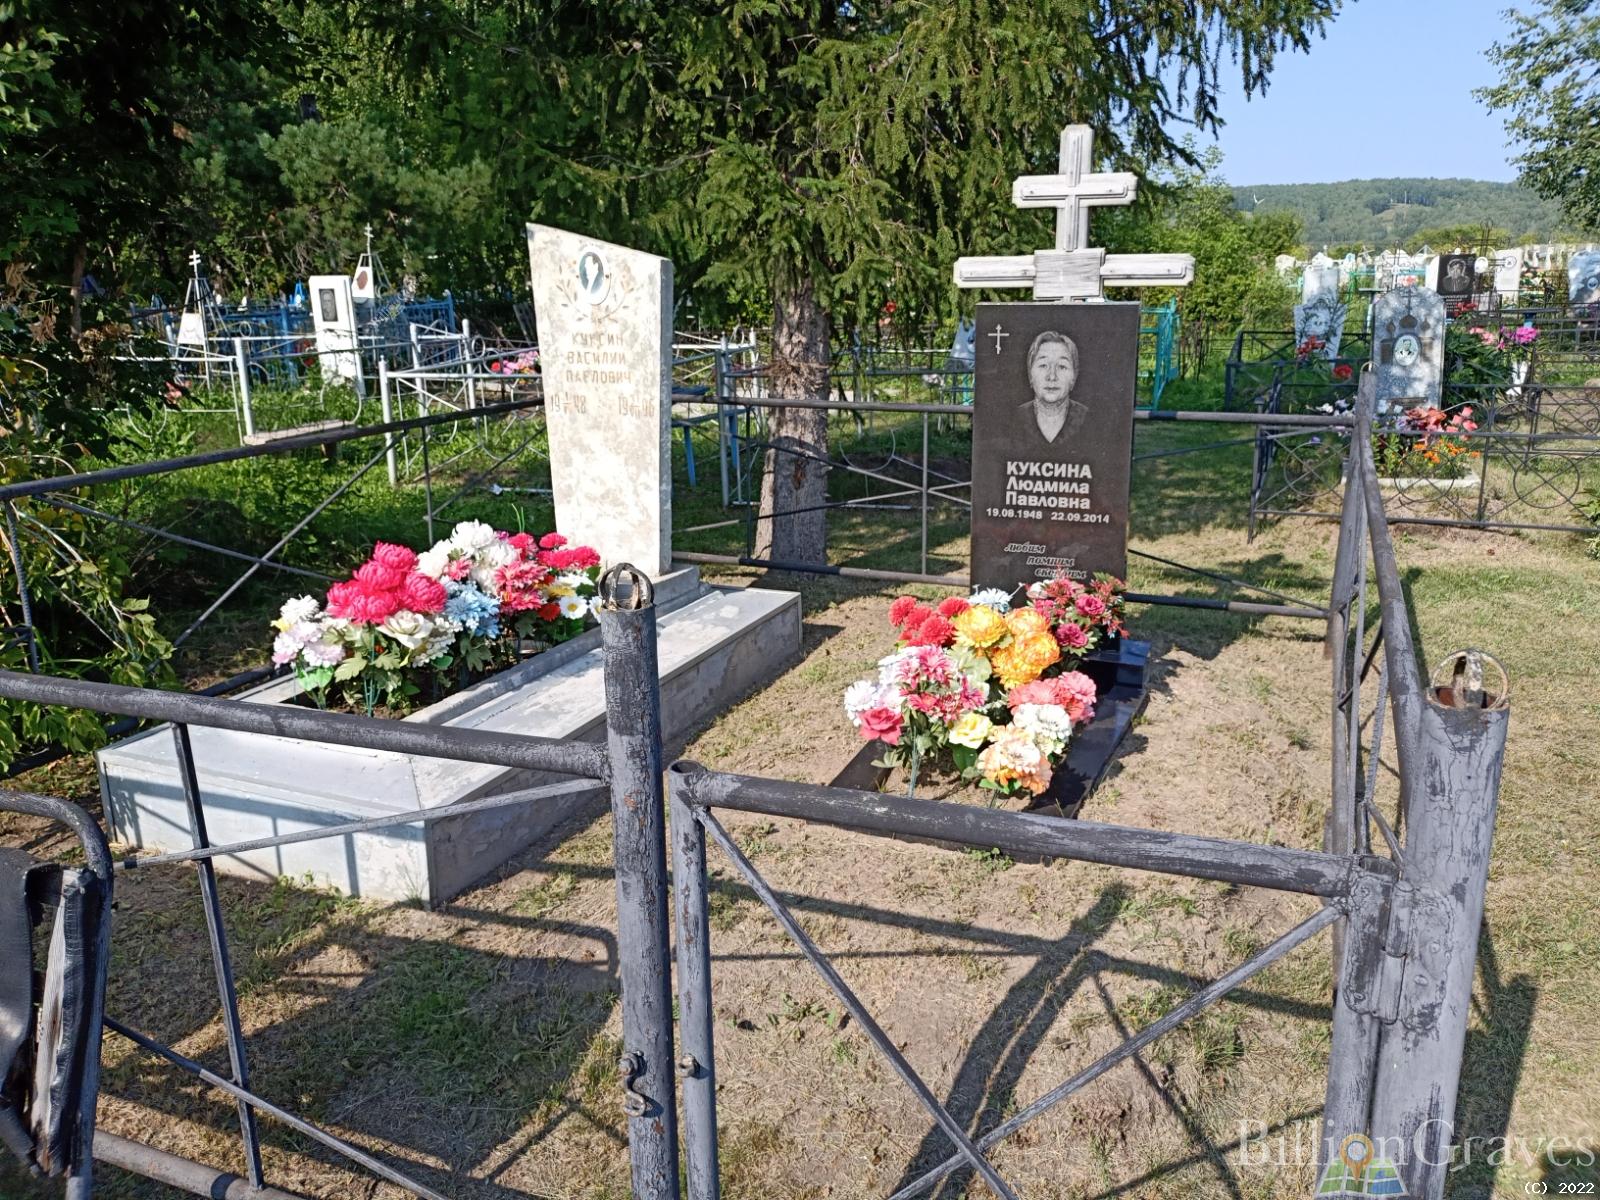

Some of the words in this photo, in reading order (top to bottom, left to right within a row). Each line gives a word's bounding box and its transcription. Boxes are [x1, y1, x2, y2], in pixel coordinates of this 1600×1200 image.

[1006, 461, 1093, 479] КУКСИНА
[1006, 476, 1090, 494] Людмила
[1005, 491, 1091, 510] Павловна
[1050, 511, 1110, 524] 22.09.2014
